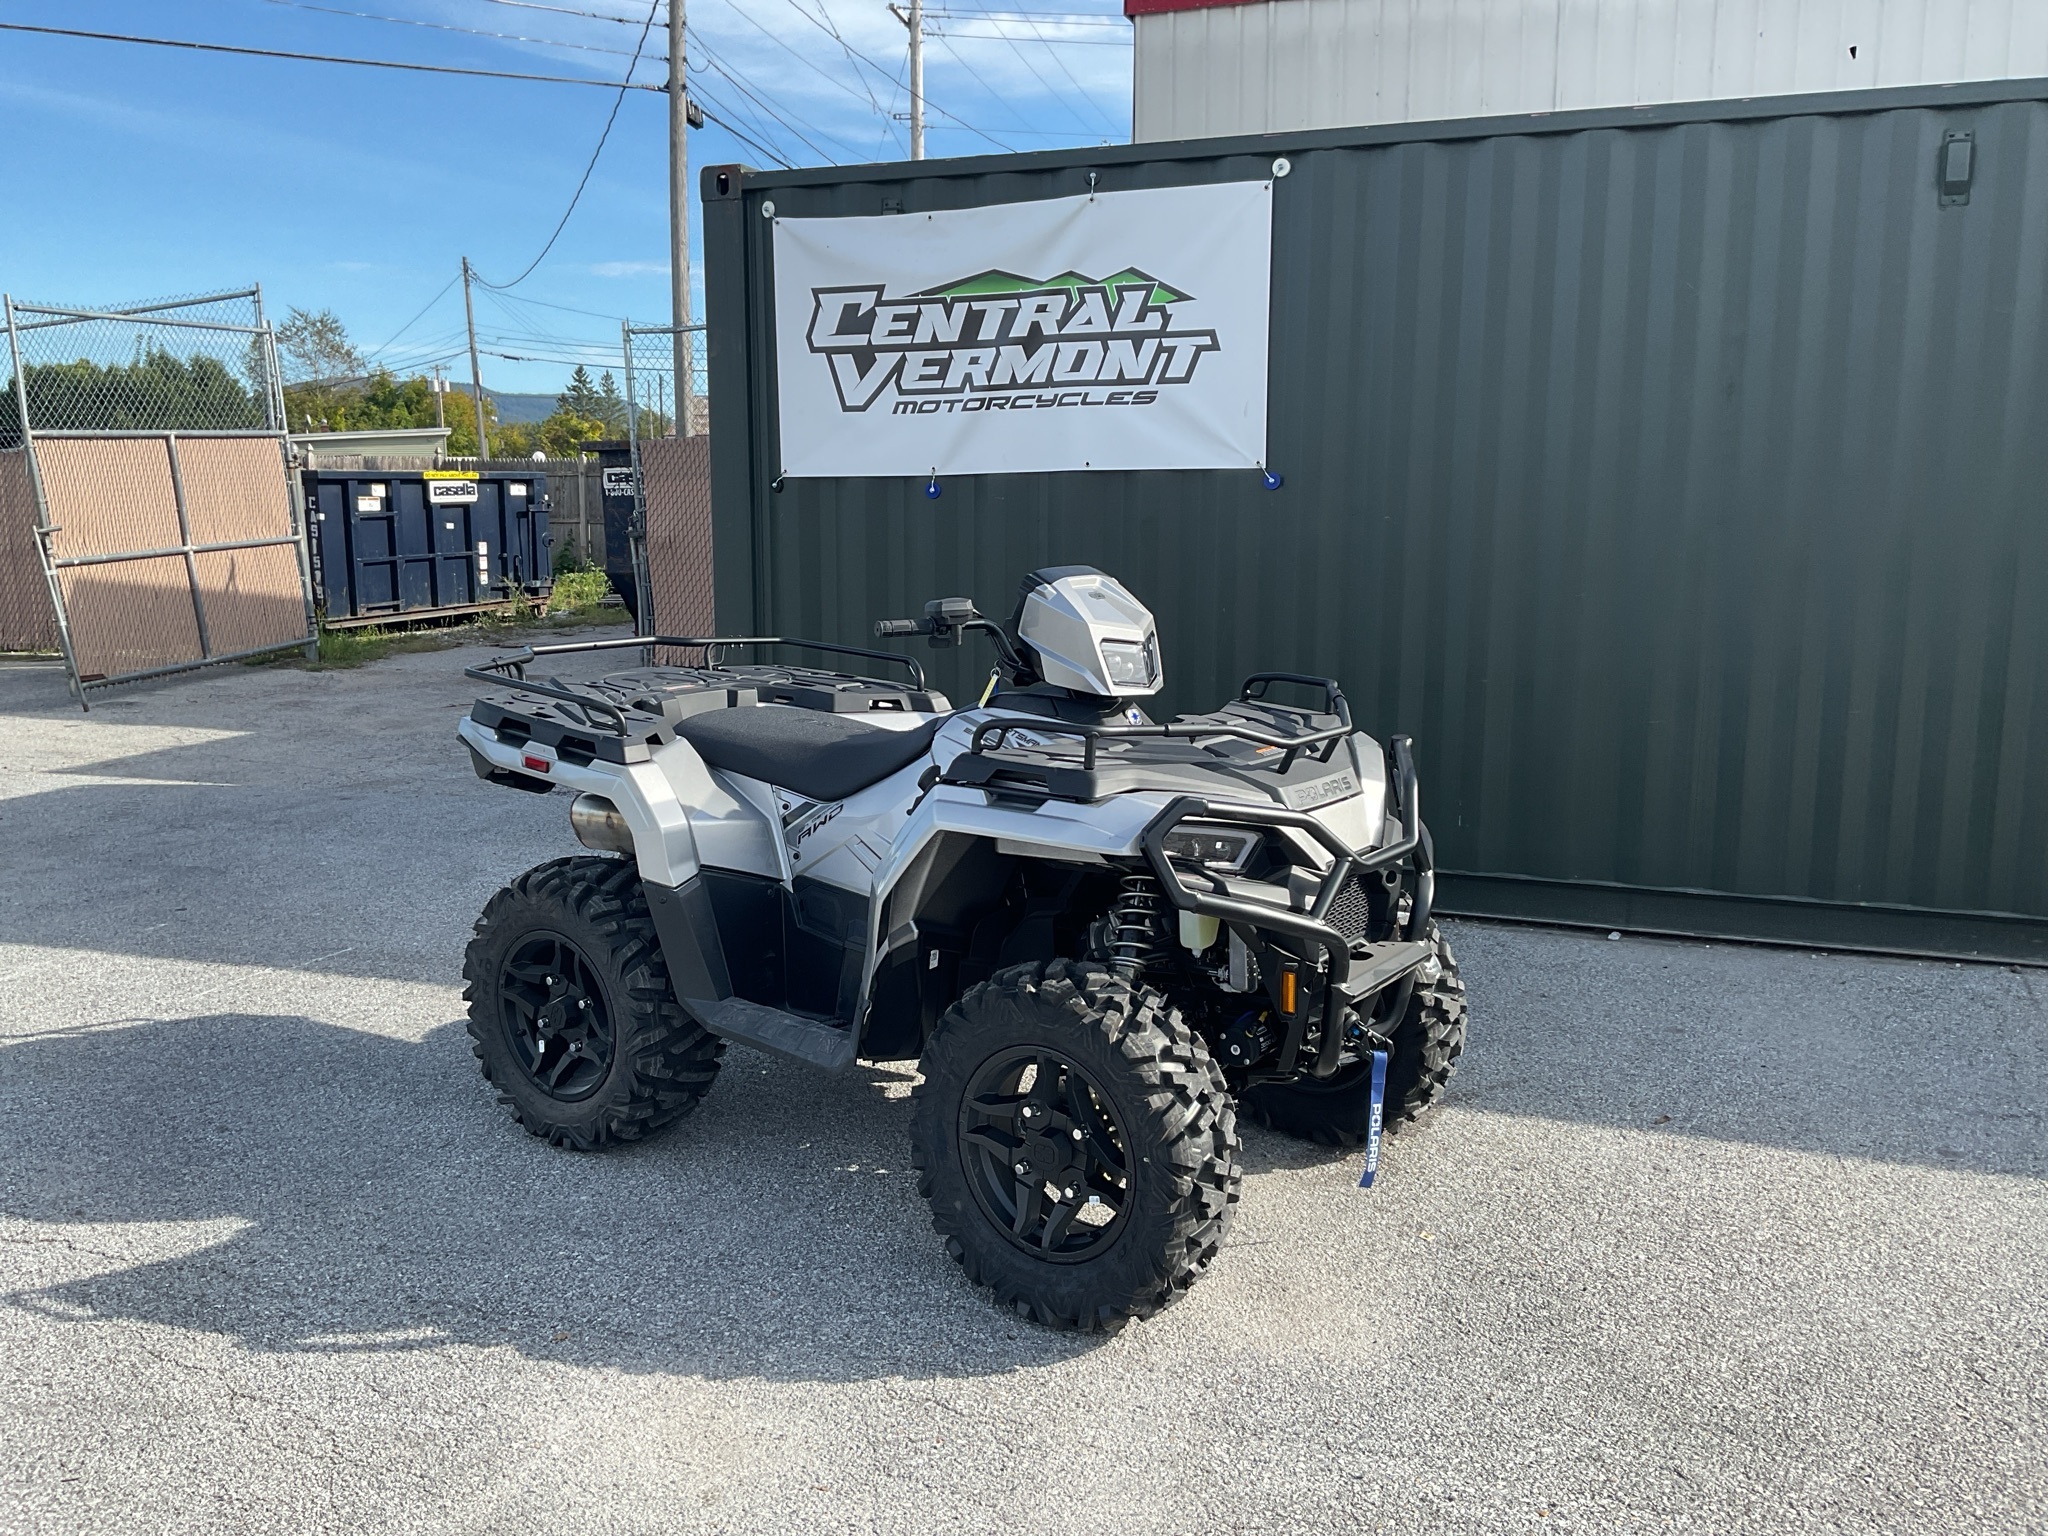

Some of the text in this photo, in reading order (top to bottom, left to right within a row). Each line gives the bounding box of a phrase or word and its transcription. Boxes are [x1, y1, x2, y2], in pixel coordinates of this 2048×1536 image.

[809, 281, 1216, 350] CENTRAL
[826, 335, 1219, 412] VERMONT
[892, 389, 1159, 415] MOTORCYCLES
[433, 483, 476, 497] casella
[1294, 776, 1353, 805] POLARIS
[797, 803, 844, 845] AWD
[1367, 1103, 1382, 1173] POLARIS
